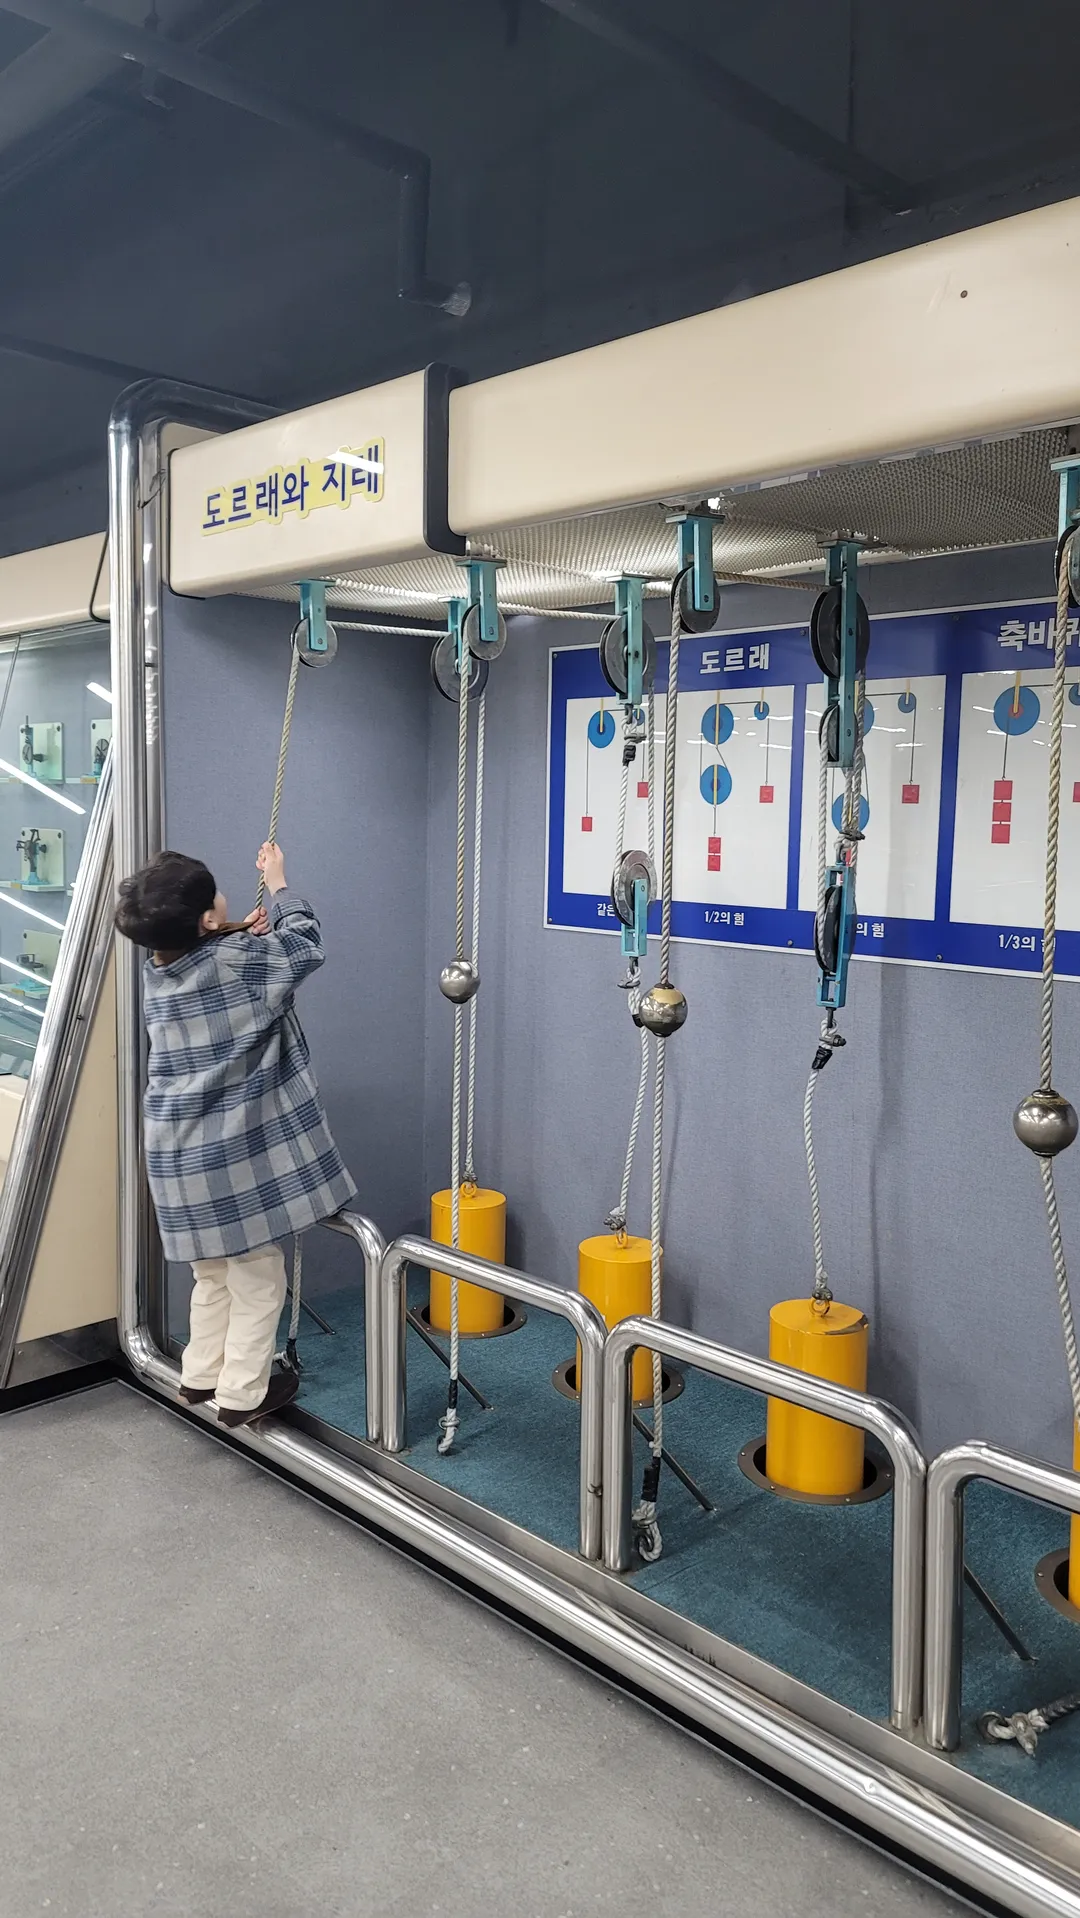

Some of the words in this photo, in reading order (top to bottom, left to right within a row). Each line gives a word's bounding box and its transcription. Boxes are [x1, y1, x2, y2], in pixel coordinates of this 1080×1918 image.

[202, 465, 310, 529] 도르래와
[699, 643, 770, 675] 도르래
[704, 910, 730, 925] 1/2의
[733, 912, 745, 926] 힘
[871, 922, 885, 938] 힘
[998, 934, 1036, 952] 1/3의
